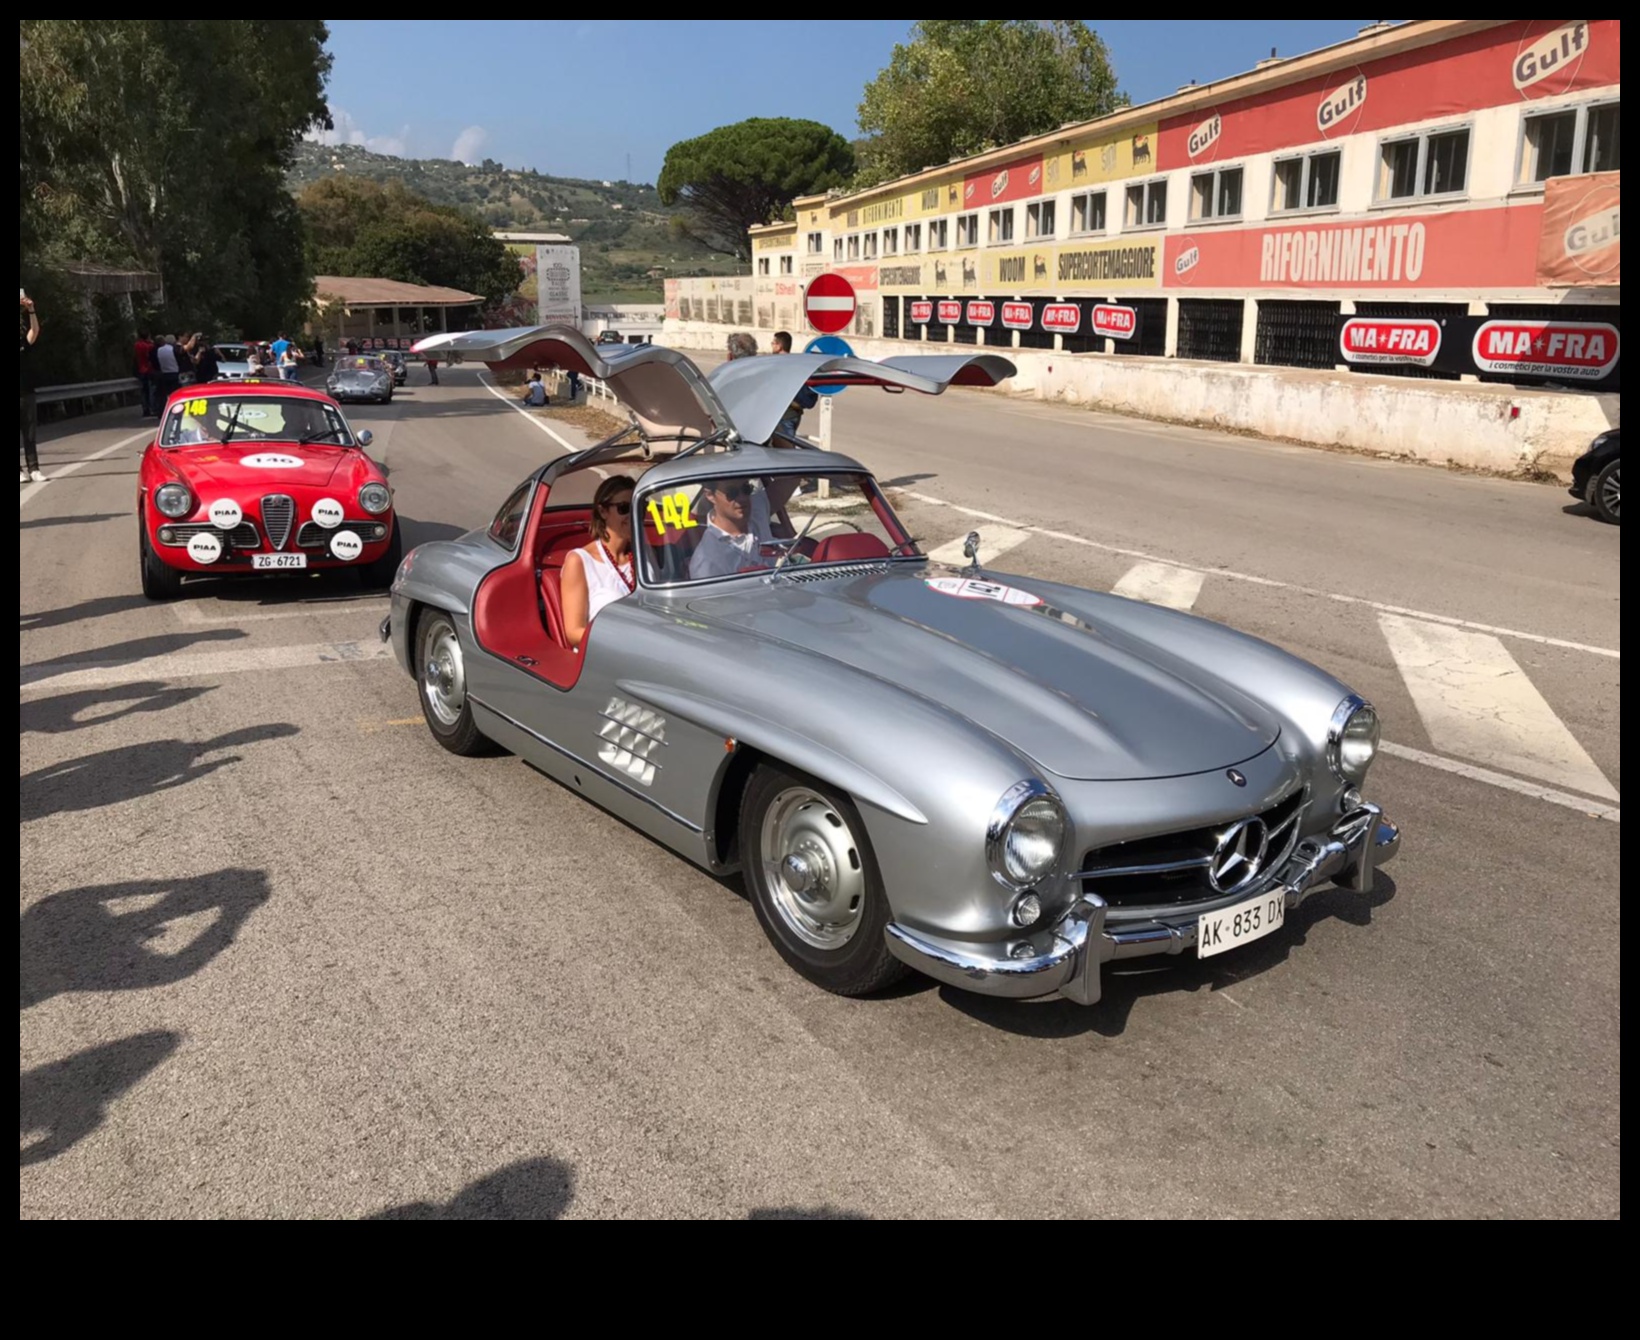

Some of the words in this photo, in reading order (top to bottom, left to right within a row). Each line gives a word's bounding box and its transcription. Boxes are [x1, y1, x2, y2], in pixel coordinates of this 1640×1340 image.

[1516, 23, 1584, 82] Gulf
[1319, 79, 1364, 125] Gulf
[1189, 117, 1220, 153] Gulf
[992, 171, 1007, 196] Gulf
[1058, 247, 1155, 280] SUPERCORTEMAGGIORE
[1176, 249, 1199, 272] Gulf
[1260, 222, 1425, 282] RIFORNIMENTO
[1494, 361, 1531, 371] cosmetici
[1531, 364, 1545, 373] per
[1552, 366, 1580, 375] vostra
[1580, 368, 1601, 377] auto
[318, 508, 340, 516] PIAA
[647, 492, 699, 535] 142
[276, 555, 302, 567] 6721
[337, 541, 359, 549] PIAA
[1201, 919, 1223, 949] AK
[1232, 905, 1262, 938] 833
